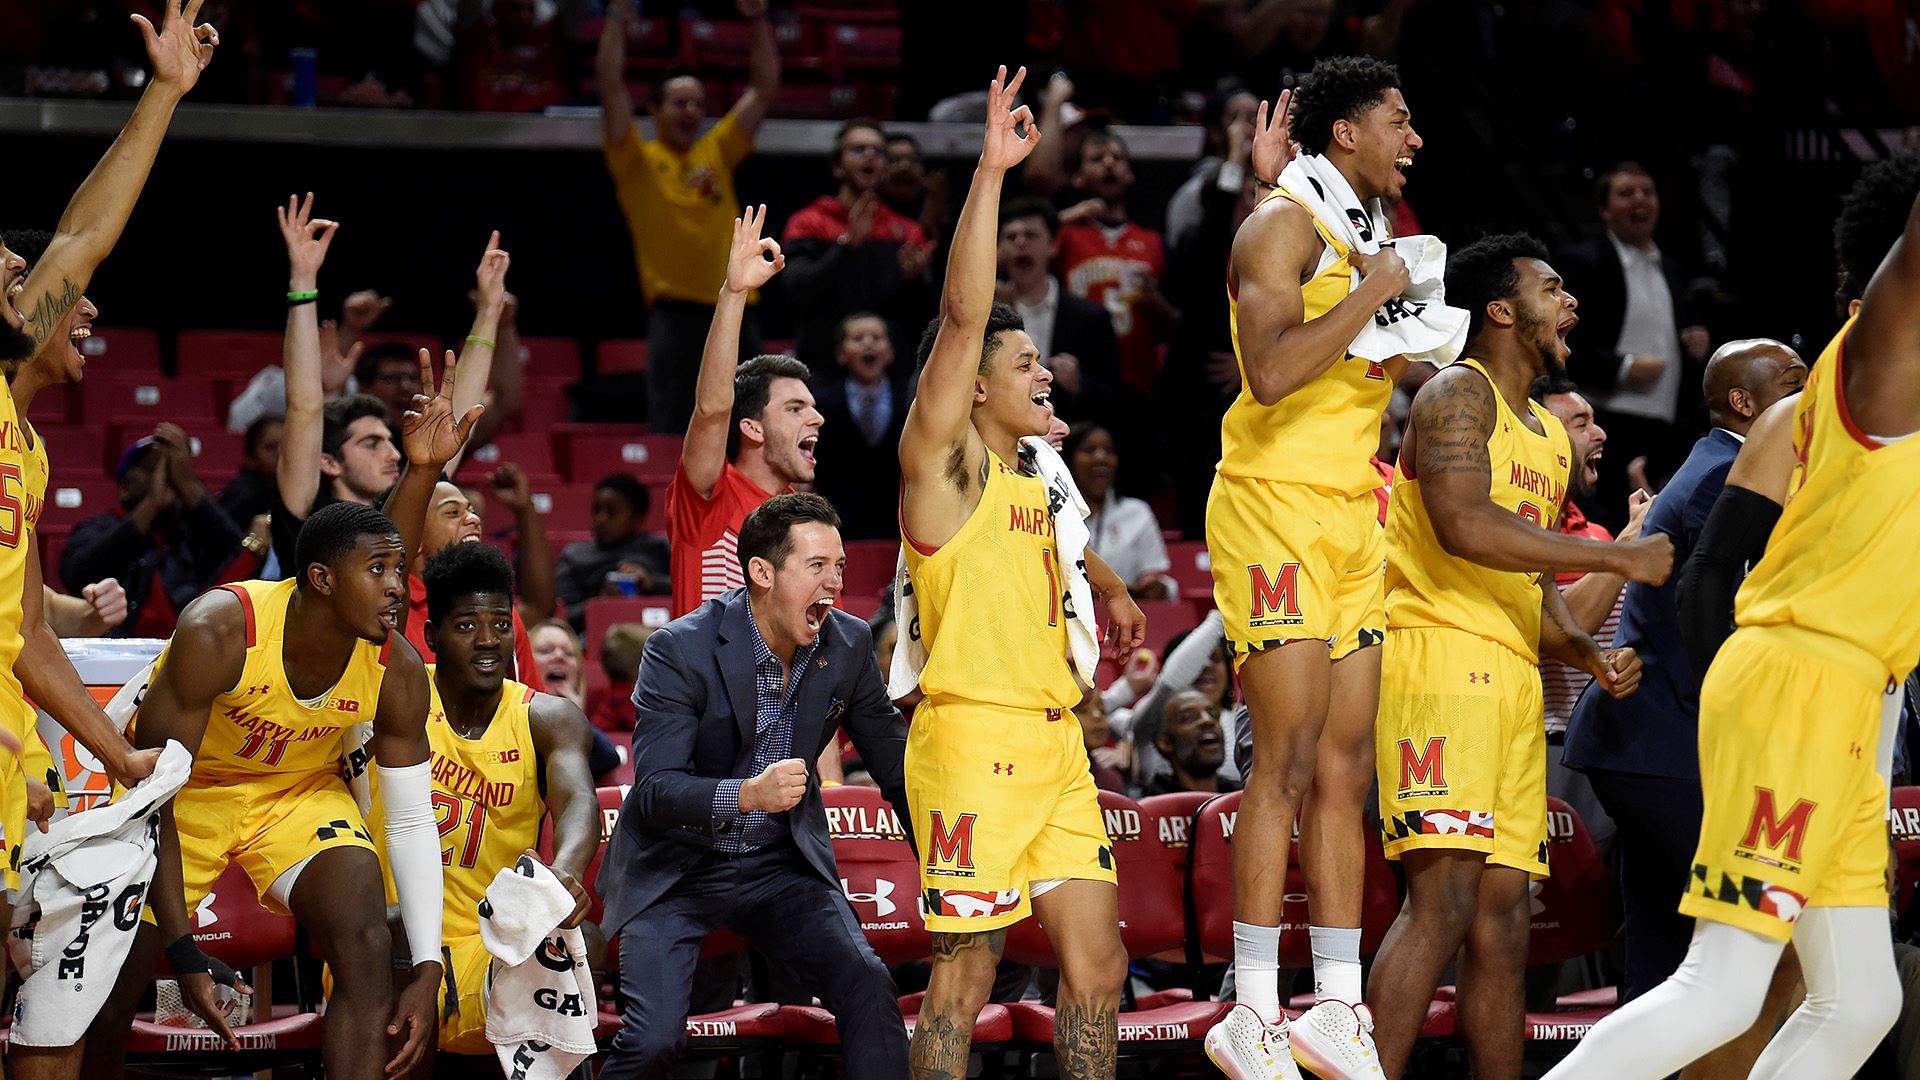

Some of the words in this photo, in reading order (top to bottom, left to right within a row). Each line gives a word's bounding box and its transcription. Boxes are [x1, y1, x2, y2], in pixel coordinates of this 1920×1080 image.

[1042, 548, 1058, 627] 1
[1247, 562, 1303, 619] M
[224, 706, 341, 743] MARYLAND
[233, 731, 291, 767] 11
[1397, 736, 1448, 792] M
[431, 789, 488, 869] 21
[926, 810, 978, 869] M
[1737, 785, 1818, 865] M
